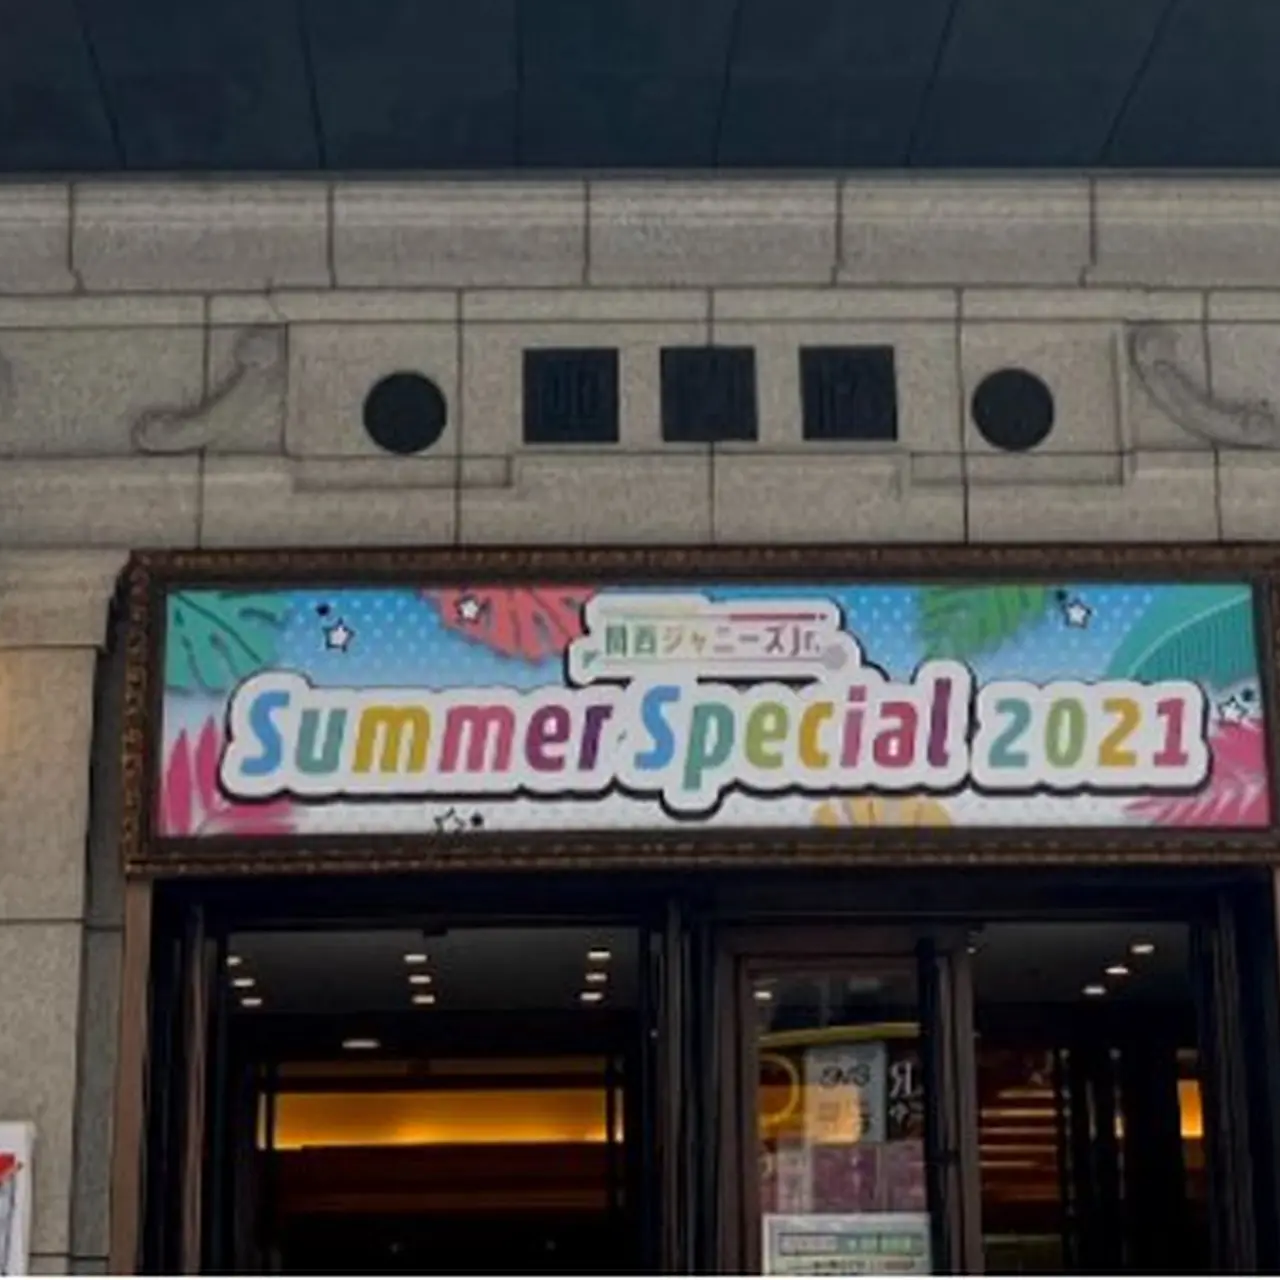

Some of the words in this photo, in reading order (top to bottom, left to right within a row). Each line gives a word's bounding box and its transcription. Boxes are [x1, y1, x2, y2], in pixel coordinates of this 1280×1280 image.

[239, 689, 613, 777] Summer
[633, 677, 953, 791] Special
[987, 697, 1190, 769] 2021
